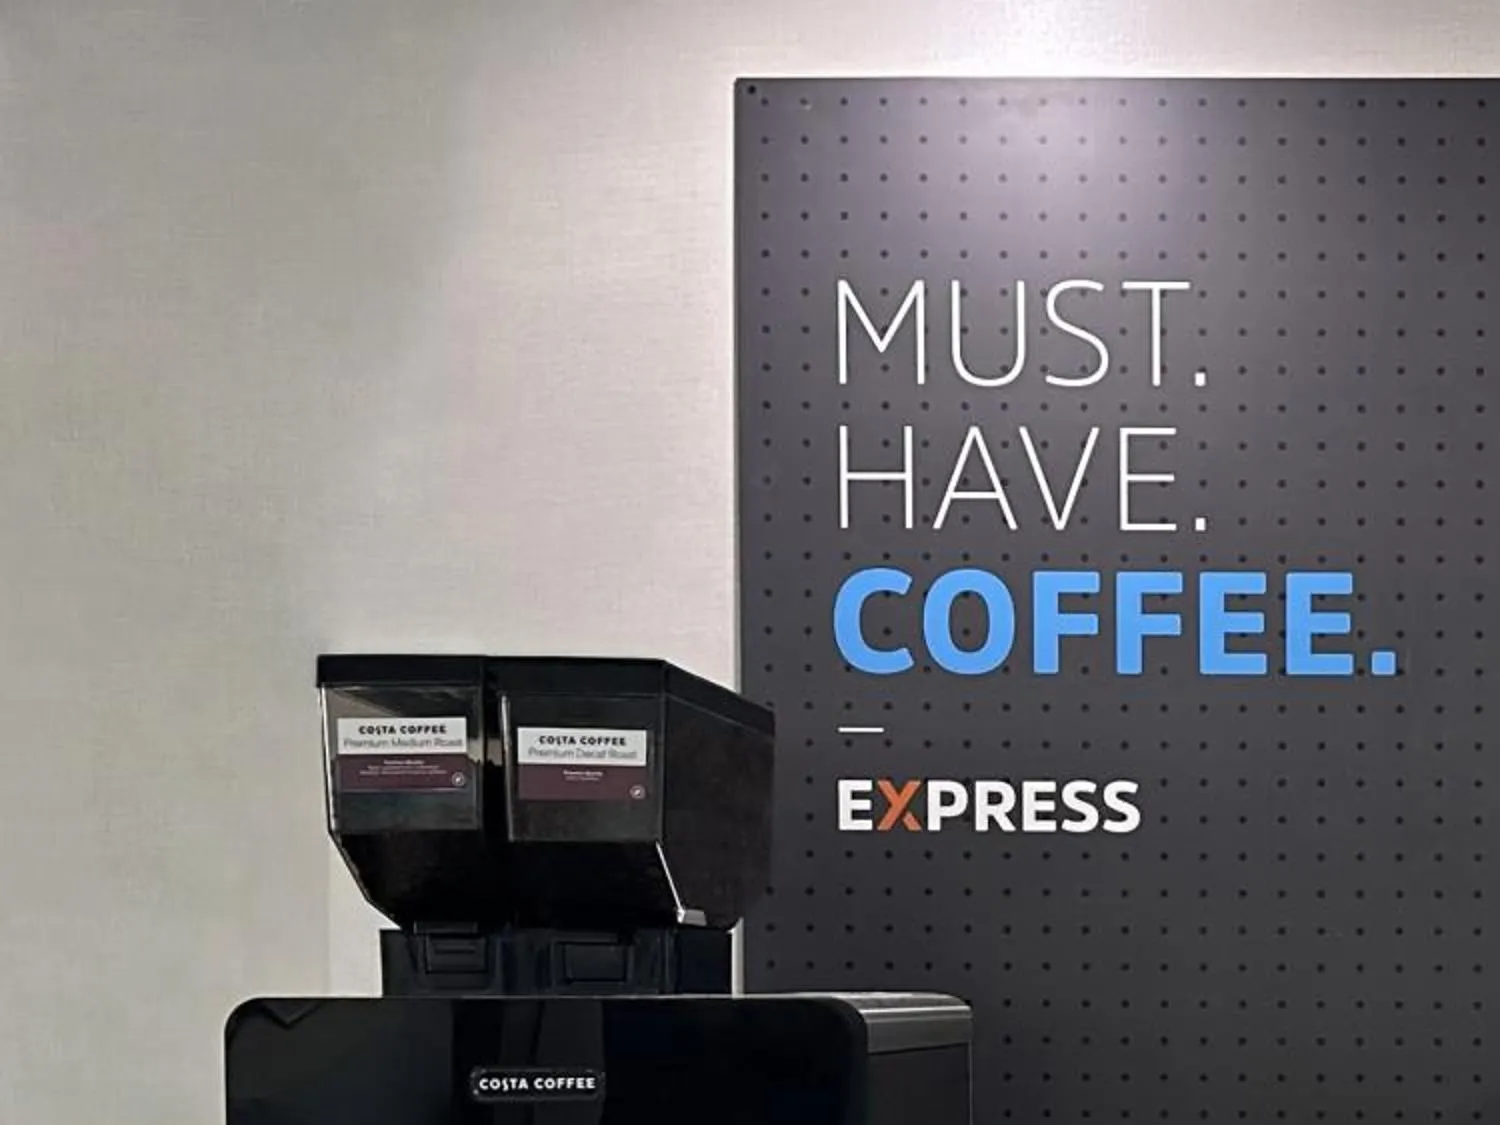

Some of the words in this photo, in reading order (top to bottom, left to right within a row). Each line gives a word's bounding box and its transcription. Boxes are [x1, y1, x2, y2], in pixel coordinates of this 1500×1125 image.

[837, 279, 1206, 387] MUST.
[838, 425, 1206, 531] HAVE.
[833, 567, 1396, 675] COFFEE.
[358, 725, 396, 735] COSTA
[399, 725, 447, 735] COFFEE
[539, 736, 576, 746] COSTA
[580, 736, 626, 746] COFFEE
[837, 779, 1141, 833] EXPRESS
[479, 1078, 529, 1091] COSTA
[533, 1077, 596, 1090] COFFEE
